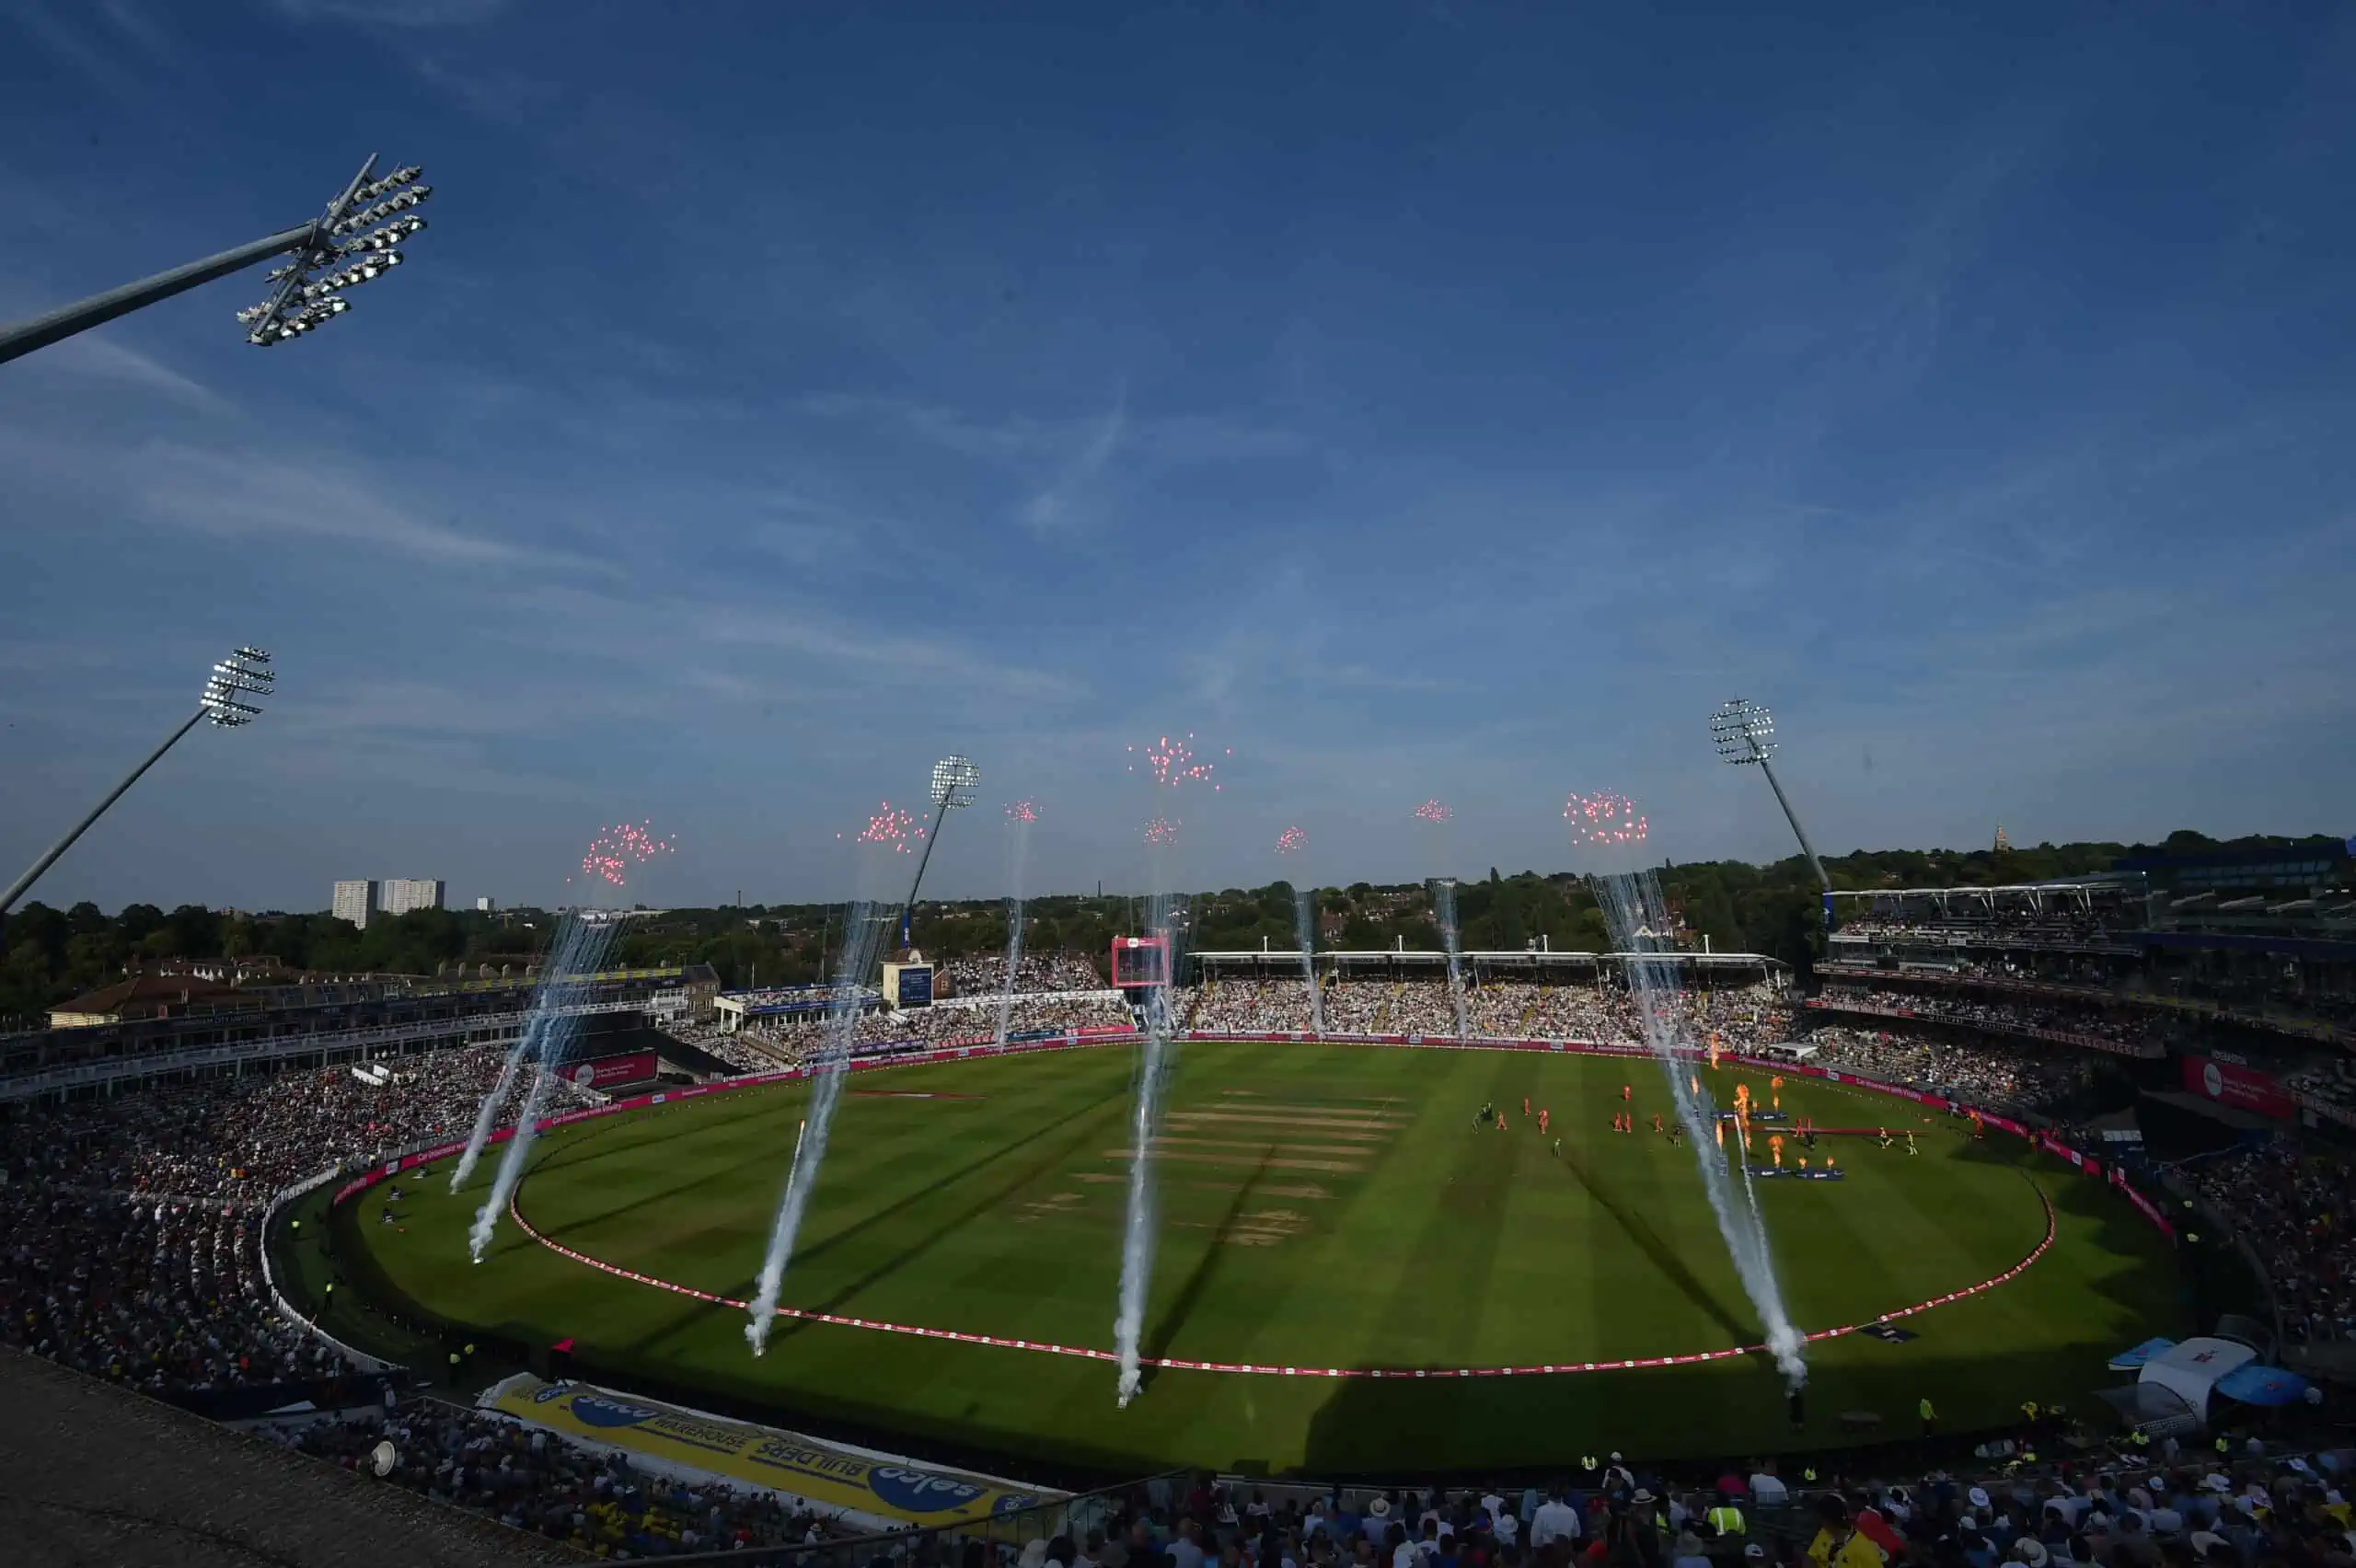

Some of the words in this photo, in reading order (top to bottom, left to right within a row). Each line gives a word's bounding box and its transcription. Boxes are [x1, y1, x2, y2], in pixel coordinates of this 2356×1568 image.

[603, 1102, 621, 1113] Vitality
[756, 1441, 869, 1474] BUILDERS
[878, 1467, 977, 1496] selco
